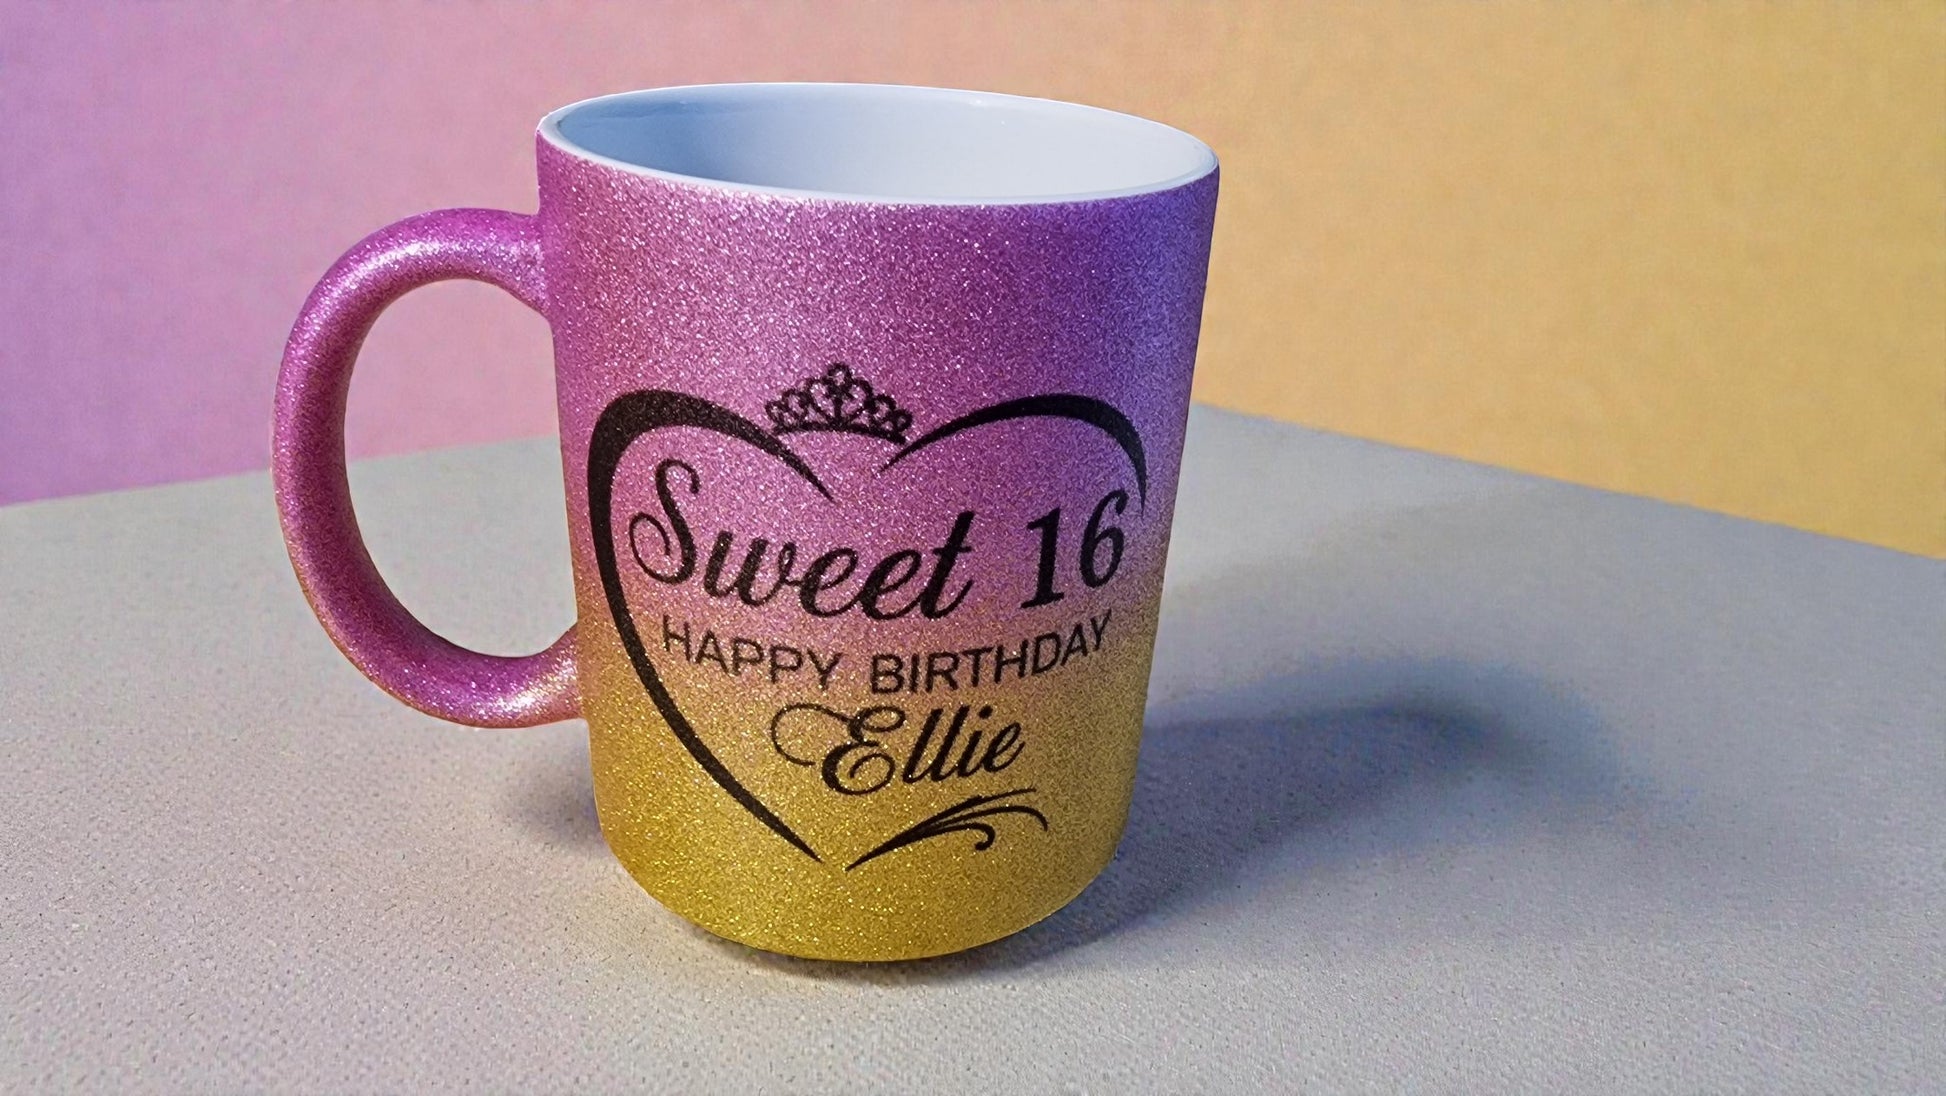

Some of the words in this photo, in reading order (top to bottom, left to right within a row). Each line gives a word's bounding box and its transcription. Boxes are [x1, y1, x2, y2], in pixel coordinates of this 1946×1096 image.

[628, 458, 977, 622] Sweet
[1020, 488, 1128, 610] 16
[663, 615, 843, 692] HAPPY
[870, 609, 1113, 695] BIRTHDAY
[770, 703, 1027, 796] Ellie
